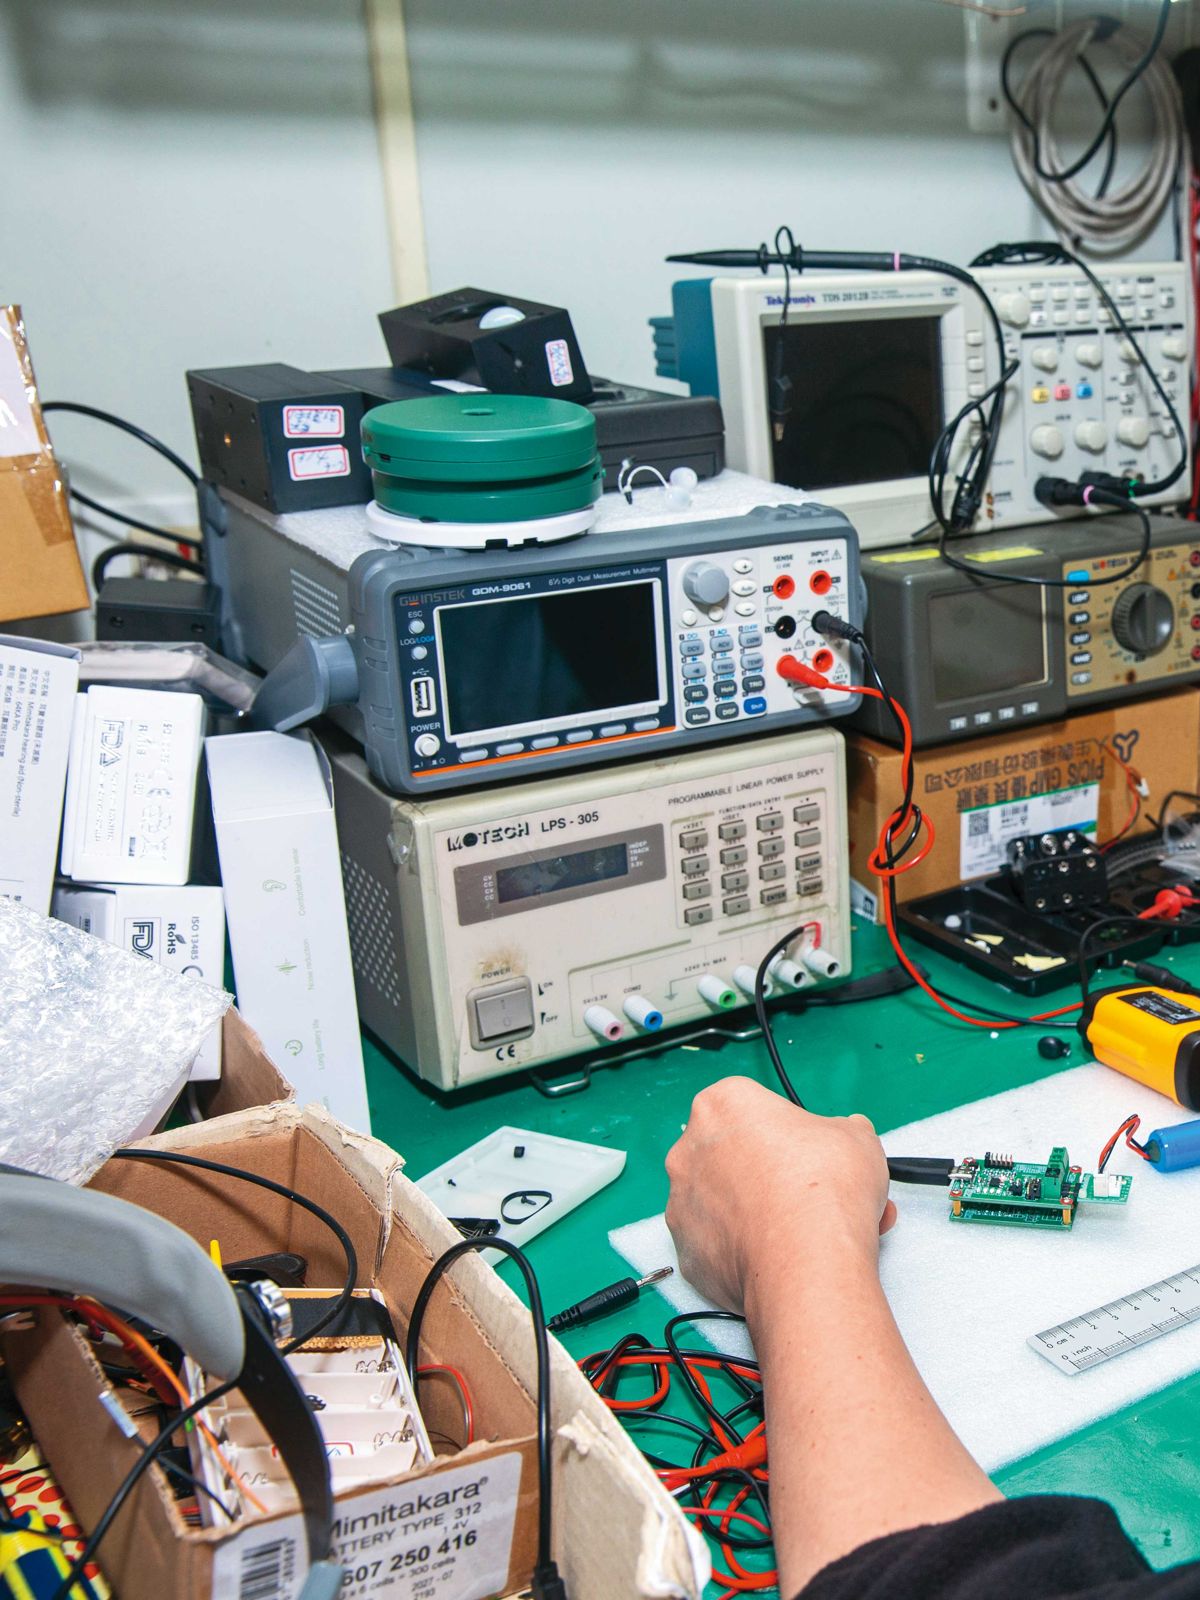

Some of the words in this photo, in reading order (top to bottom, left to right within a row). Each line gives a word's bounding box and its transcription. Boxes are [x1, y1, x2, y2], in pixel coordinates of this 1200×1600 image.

[765, 294, 816, 304] Tekronix
[773, 554, 794, 562] SENSE
[577, 574, 591, 582] Dual
[593, 569, 631, 579] Measurement
[633, 566, 661, 574] Multimeter
[472, 582, 531, 595] GDM-9061
[411, 722, 441, 733] POWER
[99, 720, 125, 767] FDA
[668, 786, 732, 805] PROGRAMMABLE
[736, 780, 762, 792] LINEAR
[766, 774, 793, 785] POWER
[797, 768, 824, 779] SUPPLY
[541, 818, 566, 833] LPS
[577, 811, 599, 825] 305
[447, 822, 530, 852] MOTECH
[294, 875, 305, 916] Comfortable
[192, 916, 200, 931] ISO
[167, 923, 176, 955] RoHS
[191, 934, 199, 960] 13485
[481, 967, 511, 980] POWER
[495, 1045, 515, 1061] CE
[1072, 1344, 1092, 1356] inch
[326, 1528, 396, 1560] ATTERY
[402, 1513, 445, 1535] TYPE
[455, 1502, 482, 1519] 312
[390, 1545, 430, 1572] 250
[437, 1530, 477, 1554] 416
[370, 1577, 395, 1590] cells
[410, 1565, 429, 1578] 300
[432, 1557, 456, 1570] cells
